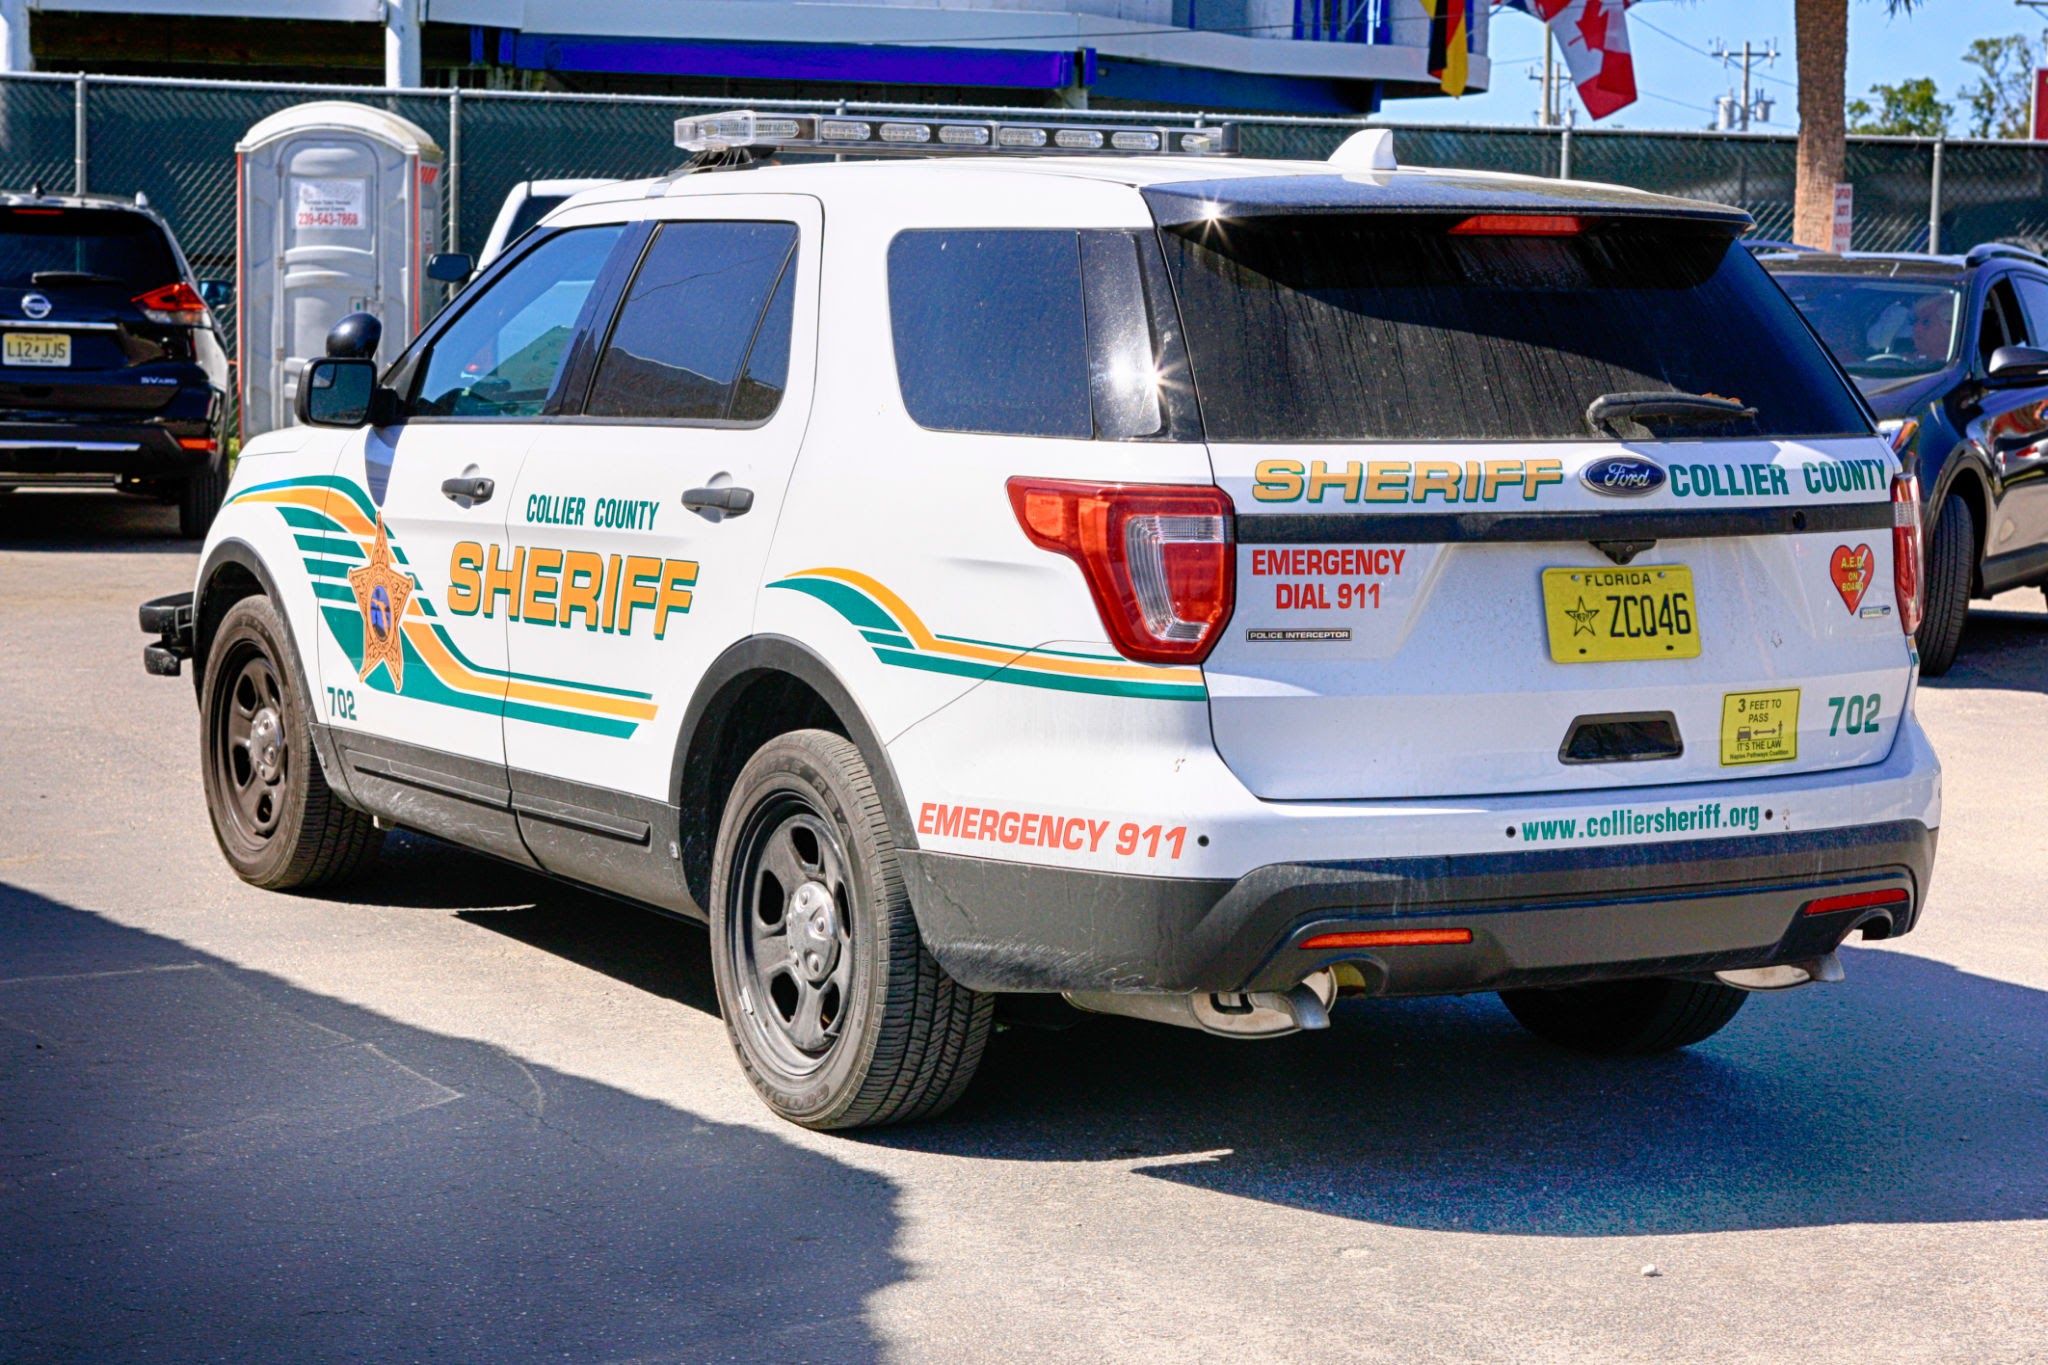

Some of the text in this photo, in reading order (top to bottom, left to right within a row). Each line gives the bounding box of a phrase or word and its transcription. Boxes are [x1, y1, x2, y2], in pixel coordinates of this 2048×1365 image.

[1252, 459, 1563, 503] SHERIFF
[1604, 463, 1650, 487] Ford
[1668, 459, 1887, 497] COLLIER COUNTY
[526, 494, 660, 531] COLLIER COUNTY
[1252, 549, 1406, 576] EMERGENCY
[447, 541, 700, 641] SHERIFF
[1584, 573, 1652, 587] FLORIDA
[1276, 583, 1381, 610] DIAL 911
[1250, 630, 1349, 639] POLICE INTERCEPTOR
[327, 686, 357, 721] 702
[1738, 698, 1782, 713] 3 FEET TO
[1748, 713, 1769, 723] PASS
[1828, 693, 1881, 737] 702
[1737, 739, 1782, 752] IT'S THE LAW
[917, 803, 1187, 860] EMERGENCY 911
[1522, 804, 1760, 842] www.colliersheriff.org
